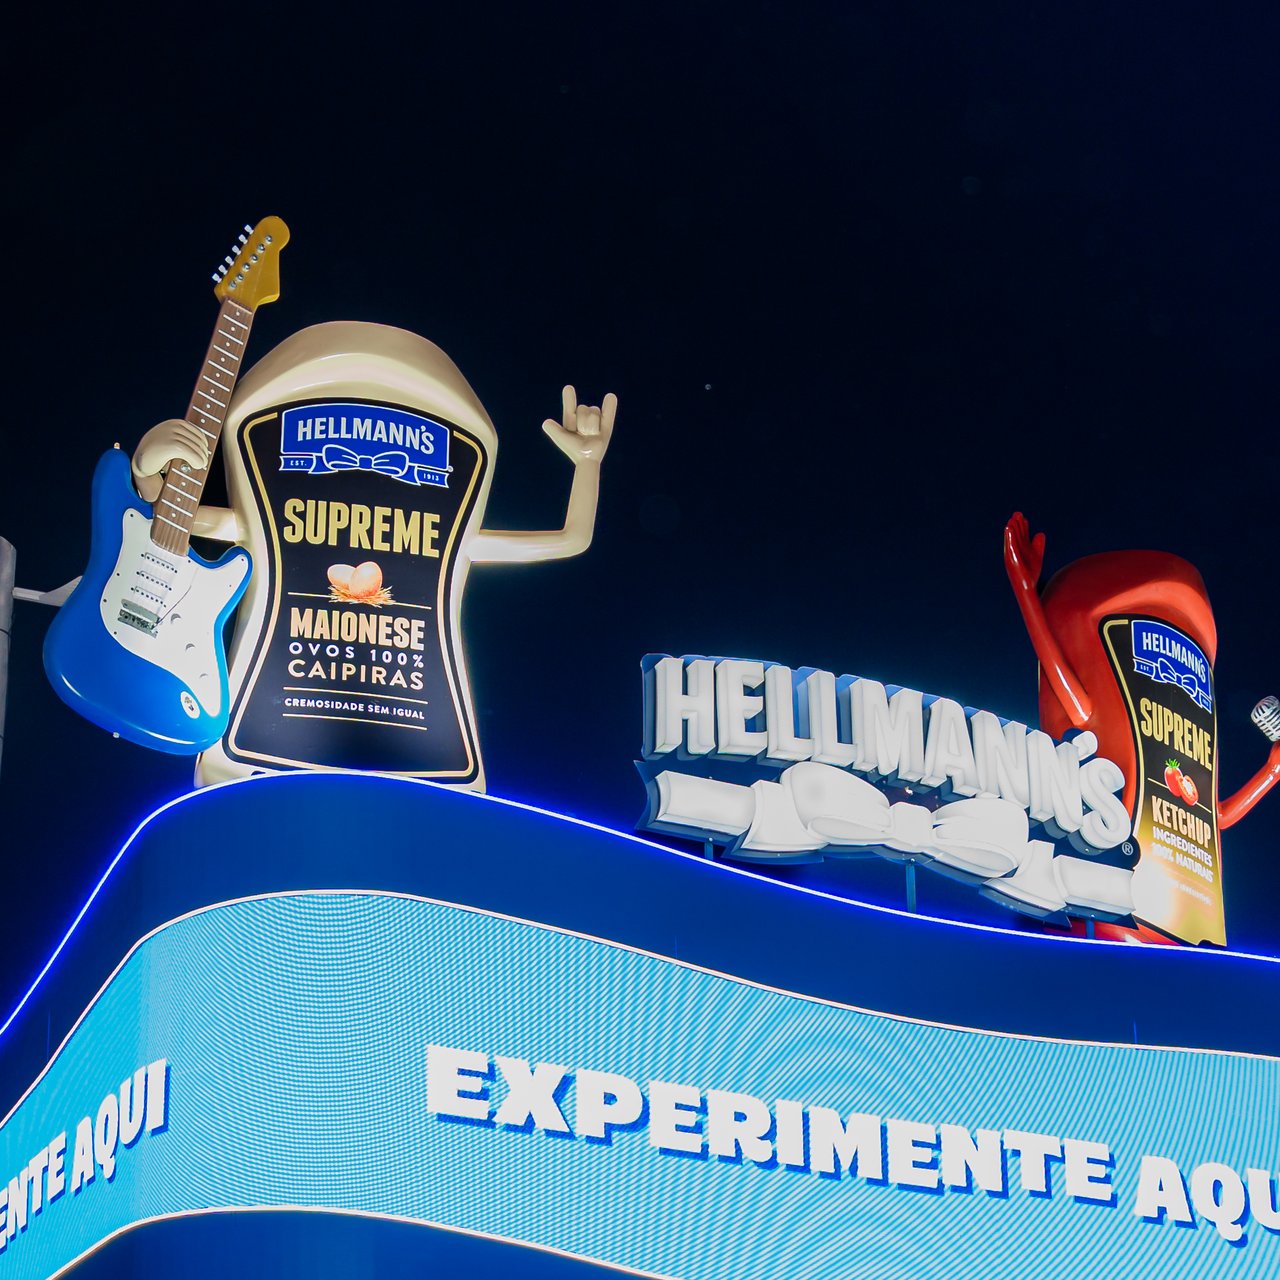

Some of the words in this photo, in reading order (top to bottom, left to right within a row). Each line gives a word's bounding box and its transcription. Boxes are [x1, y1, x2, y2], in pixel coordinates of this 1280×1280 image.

[297, 417, 435, 455] HELLMANN'S
[283, 498, 440, 558] SUPREME
[288, 642, 355, 659] OVOS
[370, 649, 425, 669] 100%
[290, 607, 426, 651] MAIONESE
[287, 659, 424, 691] CAIPIRAS
[1142, 632, 1206, 684] HELLMANN'S
[284, 697, 365, 712] CREMOSIDADE
[367, 704, 390, 715] SEM
[392, 707, 425, 720] IGUAL
[1139, 698, 1212, 771] SUPREME
[652, 655, 1132, 850] HELLMANN'S
[1152, 795, 1211, 849] KETCHUP
[70, 1058, 171, 1197] AQUI
[426, 1044, 1117, 1207] EXPERIMENTE
